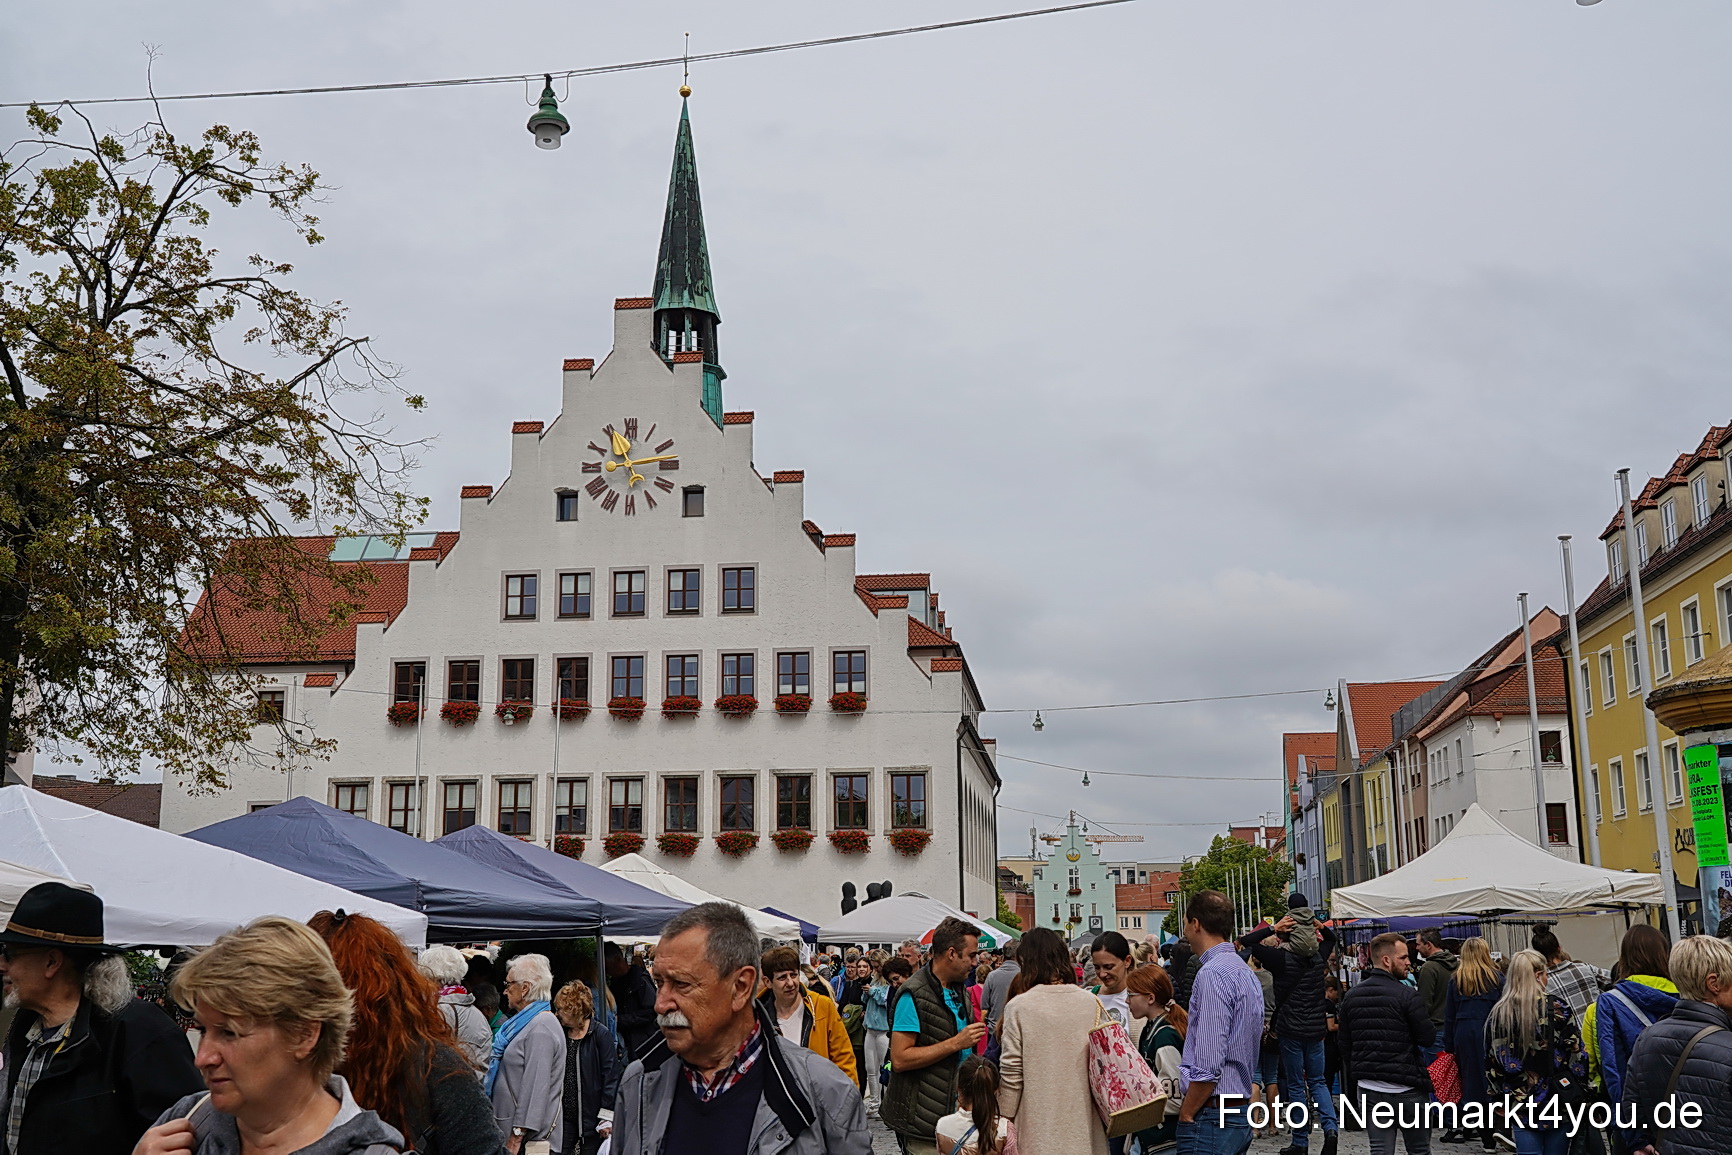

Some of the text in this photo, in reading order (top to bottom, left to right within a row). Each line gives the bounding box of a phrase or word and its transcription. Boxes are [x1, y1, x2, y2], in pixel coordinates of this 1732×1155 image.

[624, 418, 638, 439] XII
[587, 441, 607, 457] X
[655, 439, 674, 454] II
[582, 462, 602, 473] IX
[659, 460, 679, 471] III
[625, 494, 636, 516] VI
[644, 490, 657, 509] V
